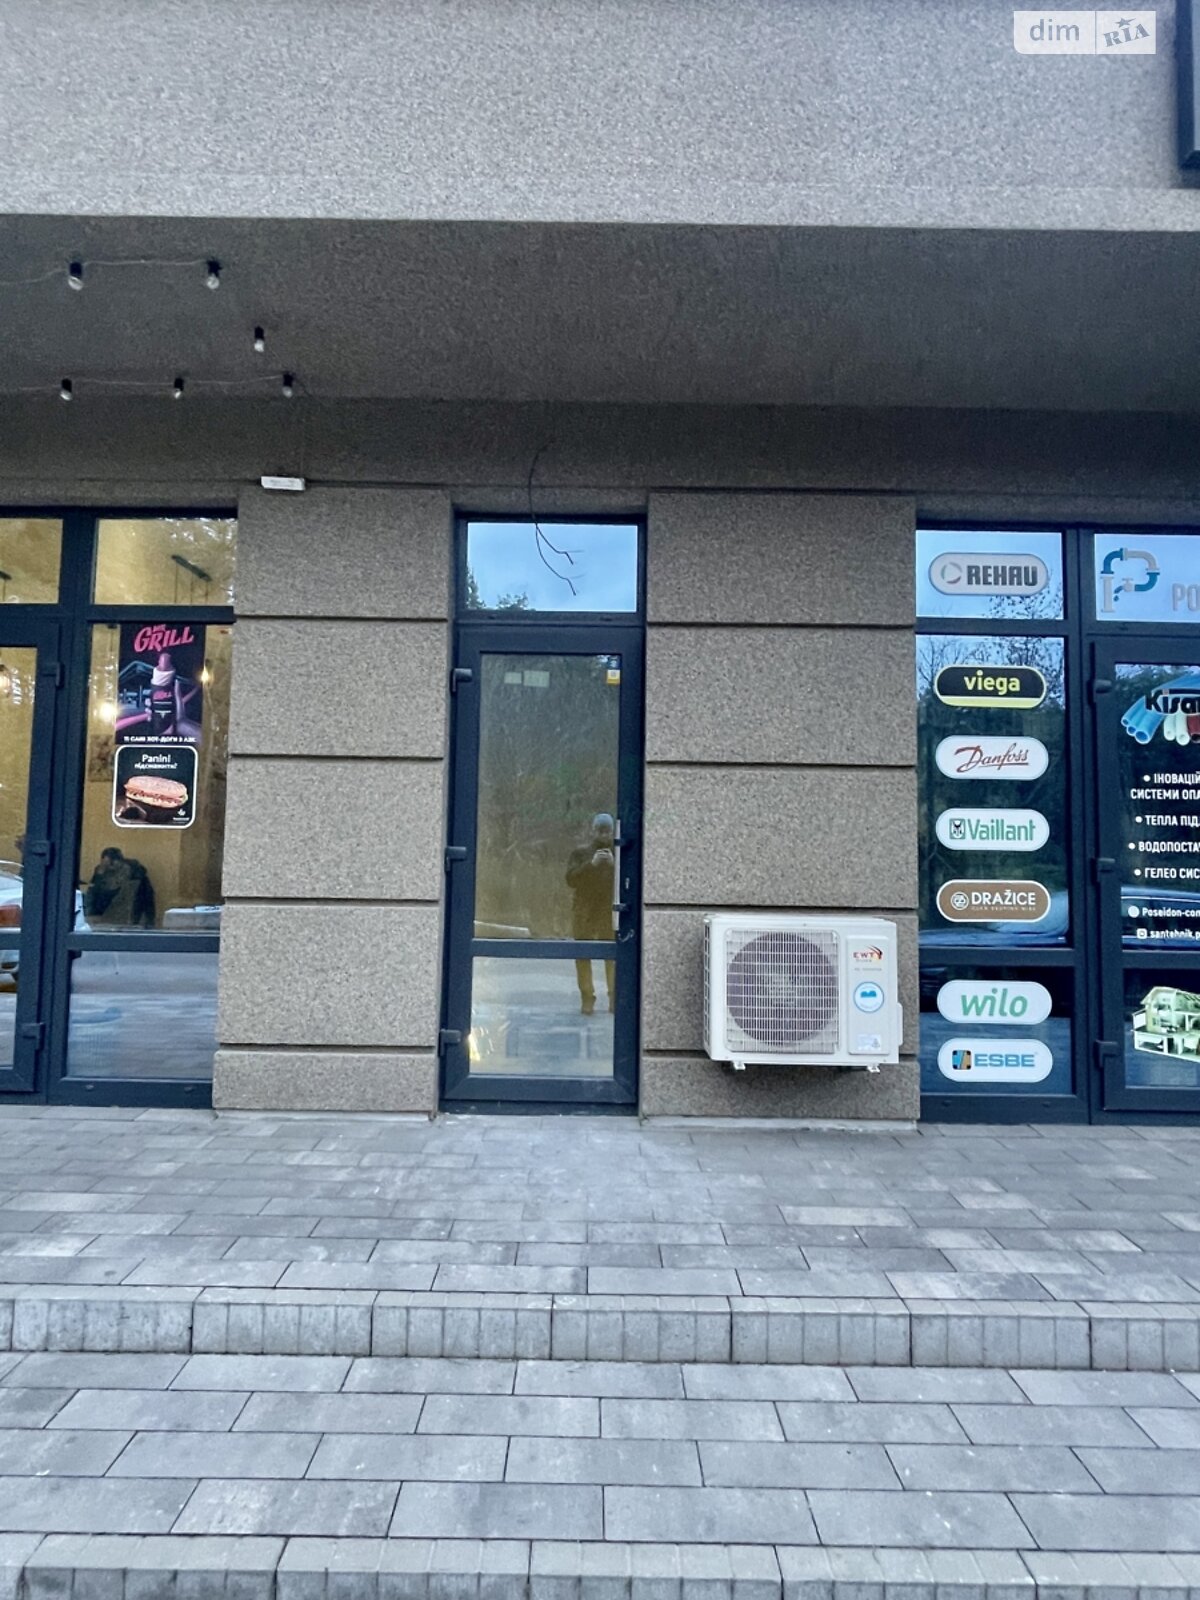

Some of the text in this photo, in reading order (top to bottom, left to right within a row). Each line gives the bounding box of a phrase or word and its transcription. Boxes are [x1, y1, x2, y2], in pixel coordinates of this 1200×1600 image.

[967, 565, 1038, 586] REHAU
[134, 626, 194, 653] GRILL
[963, 670, 1021, 695] viega
[142, 754, 171, 763] Panini
[954, 742, 1029, 773] Danfoss
[1130, 788, 1180, 800] СИСТЕМИ
[1145, 814, 1178, 826] ТЕПЛА
[967, 819, 1036, 841] Vaillant
[1144, 867, 1177, 879] ГЕЛЕО
[971, 889, 1036, 906] DRAŽICE
[961, 988, 1028, 1017] wilo
[974, 1054, 1036, 1067] ESBE
